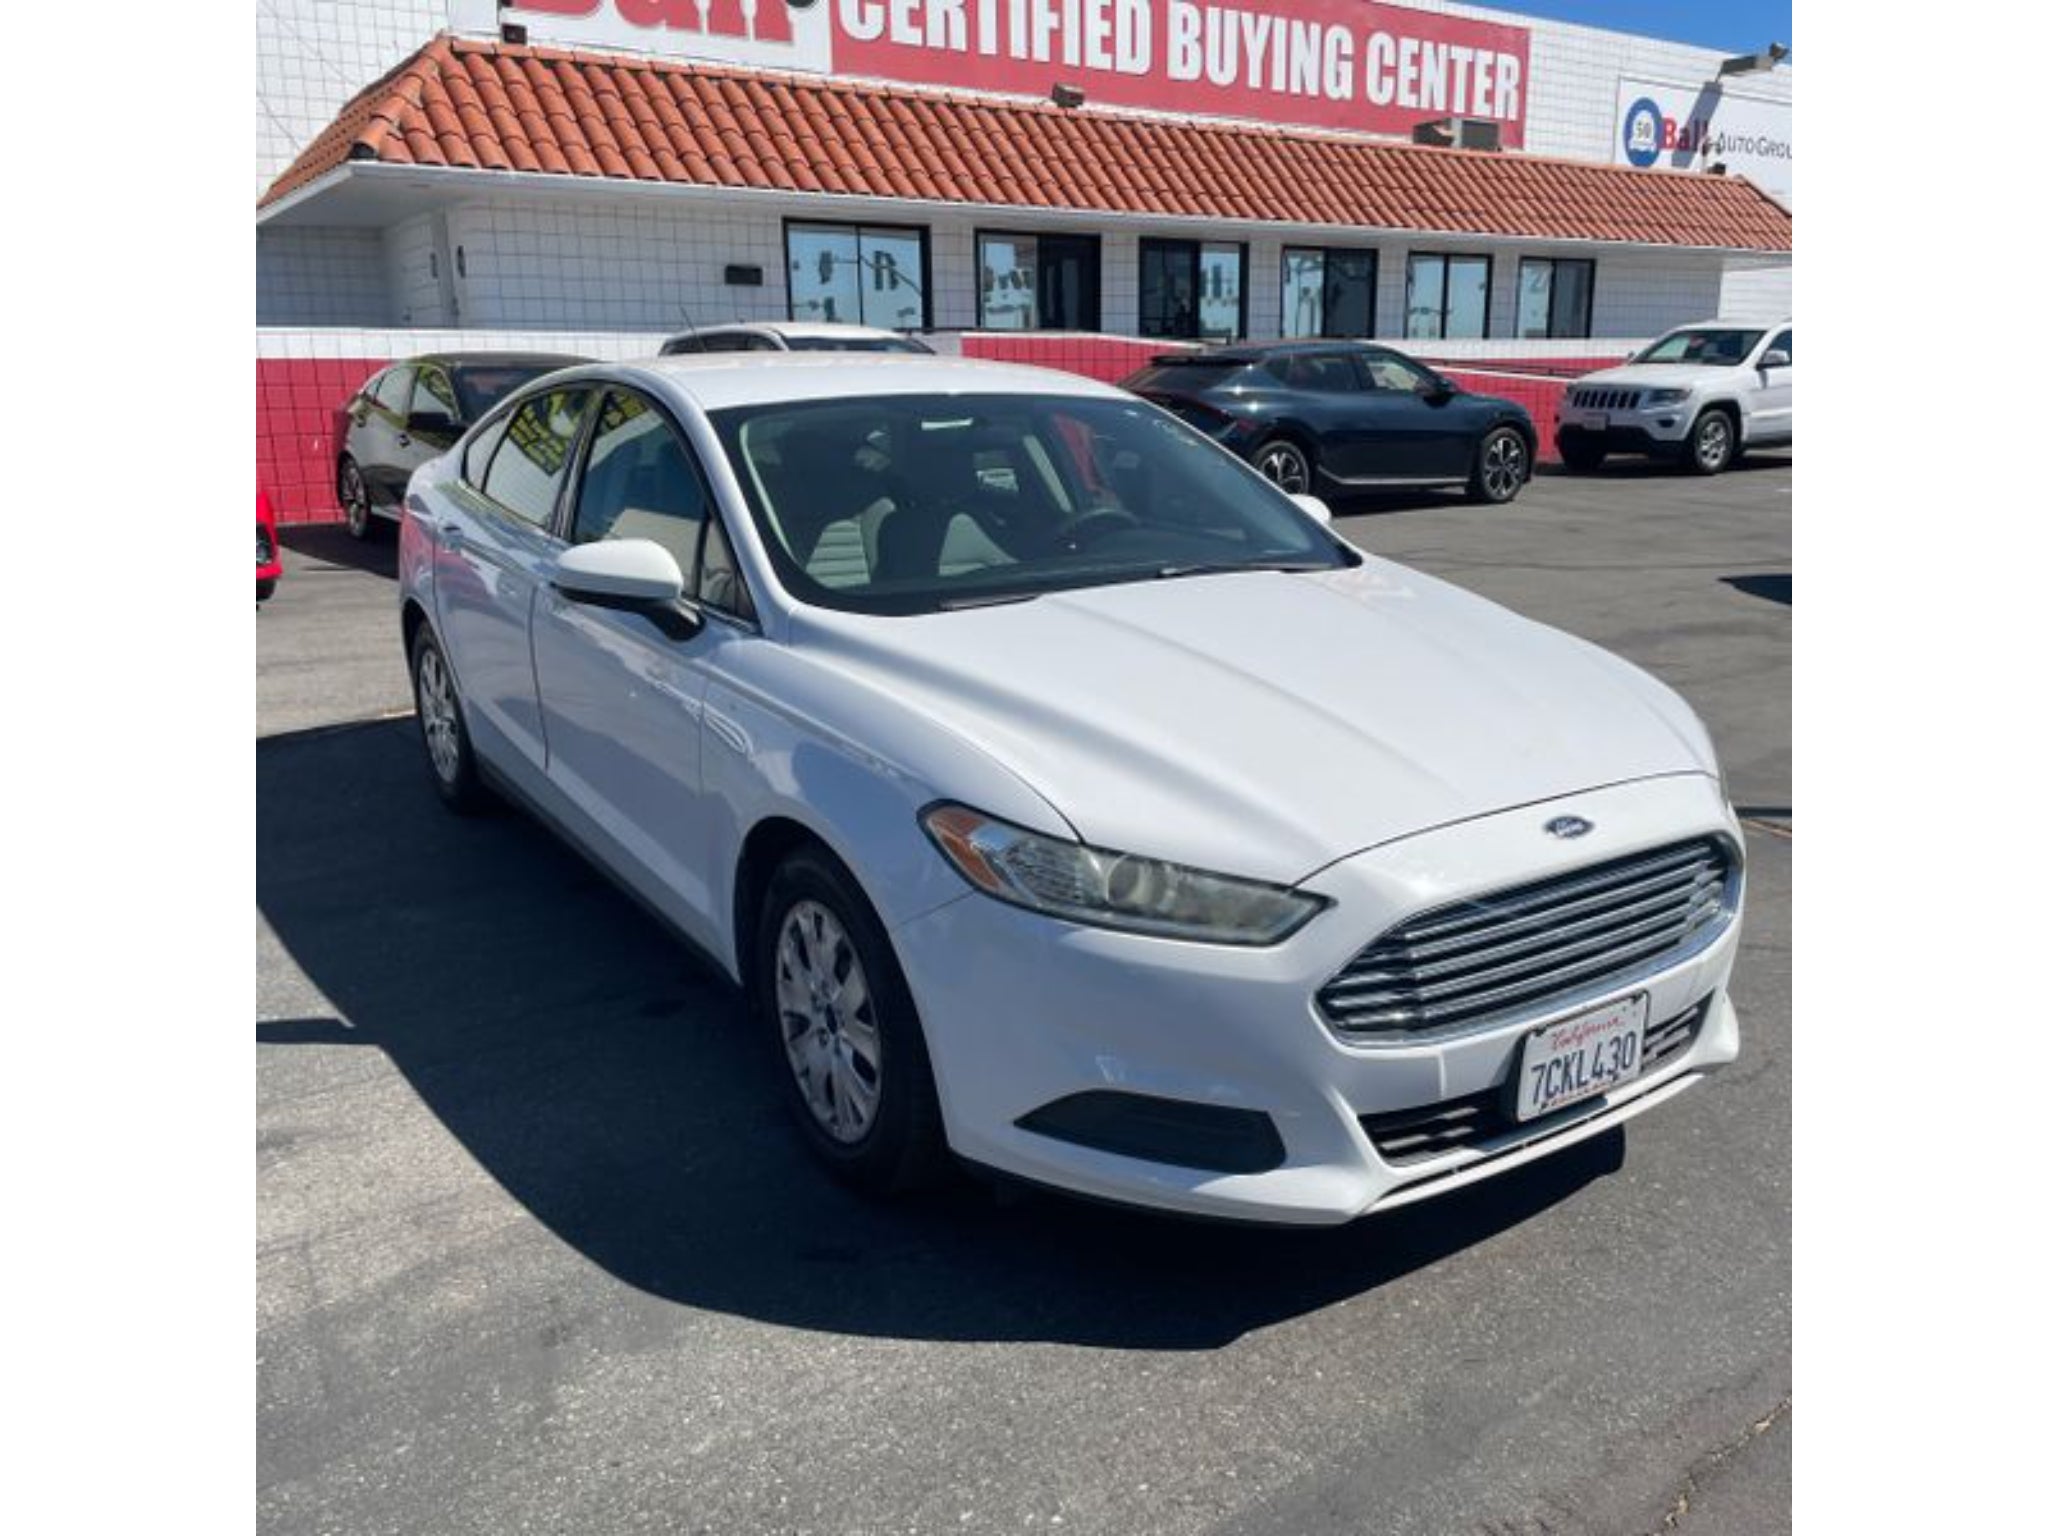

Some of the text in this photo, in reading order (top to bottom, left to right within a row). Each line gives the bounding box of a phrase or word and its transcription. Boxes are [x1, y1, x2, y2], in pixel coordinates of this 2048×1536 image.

[1167, 1, 1355, 101] BUYING
[1366, 31, 1522, 121] CENTER
[1660, 117, 1708, 152] Ball
[1553, 1016, 1622, 1051] California
[1530, 1030, 1637, 1106] 7CKL430
